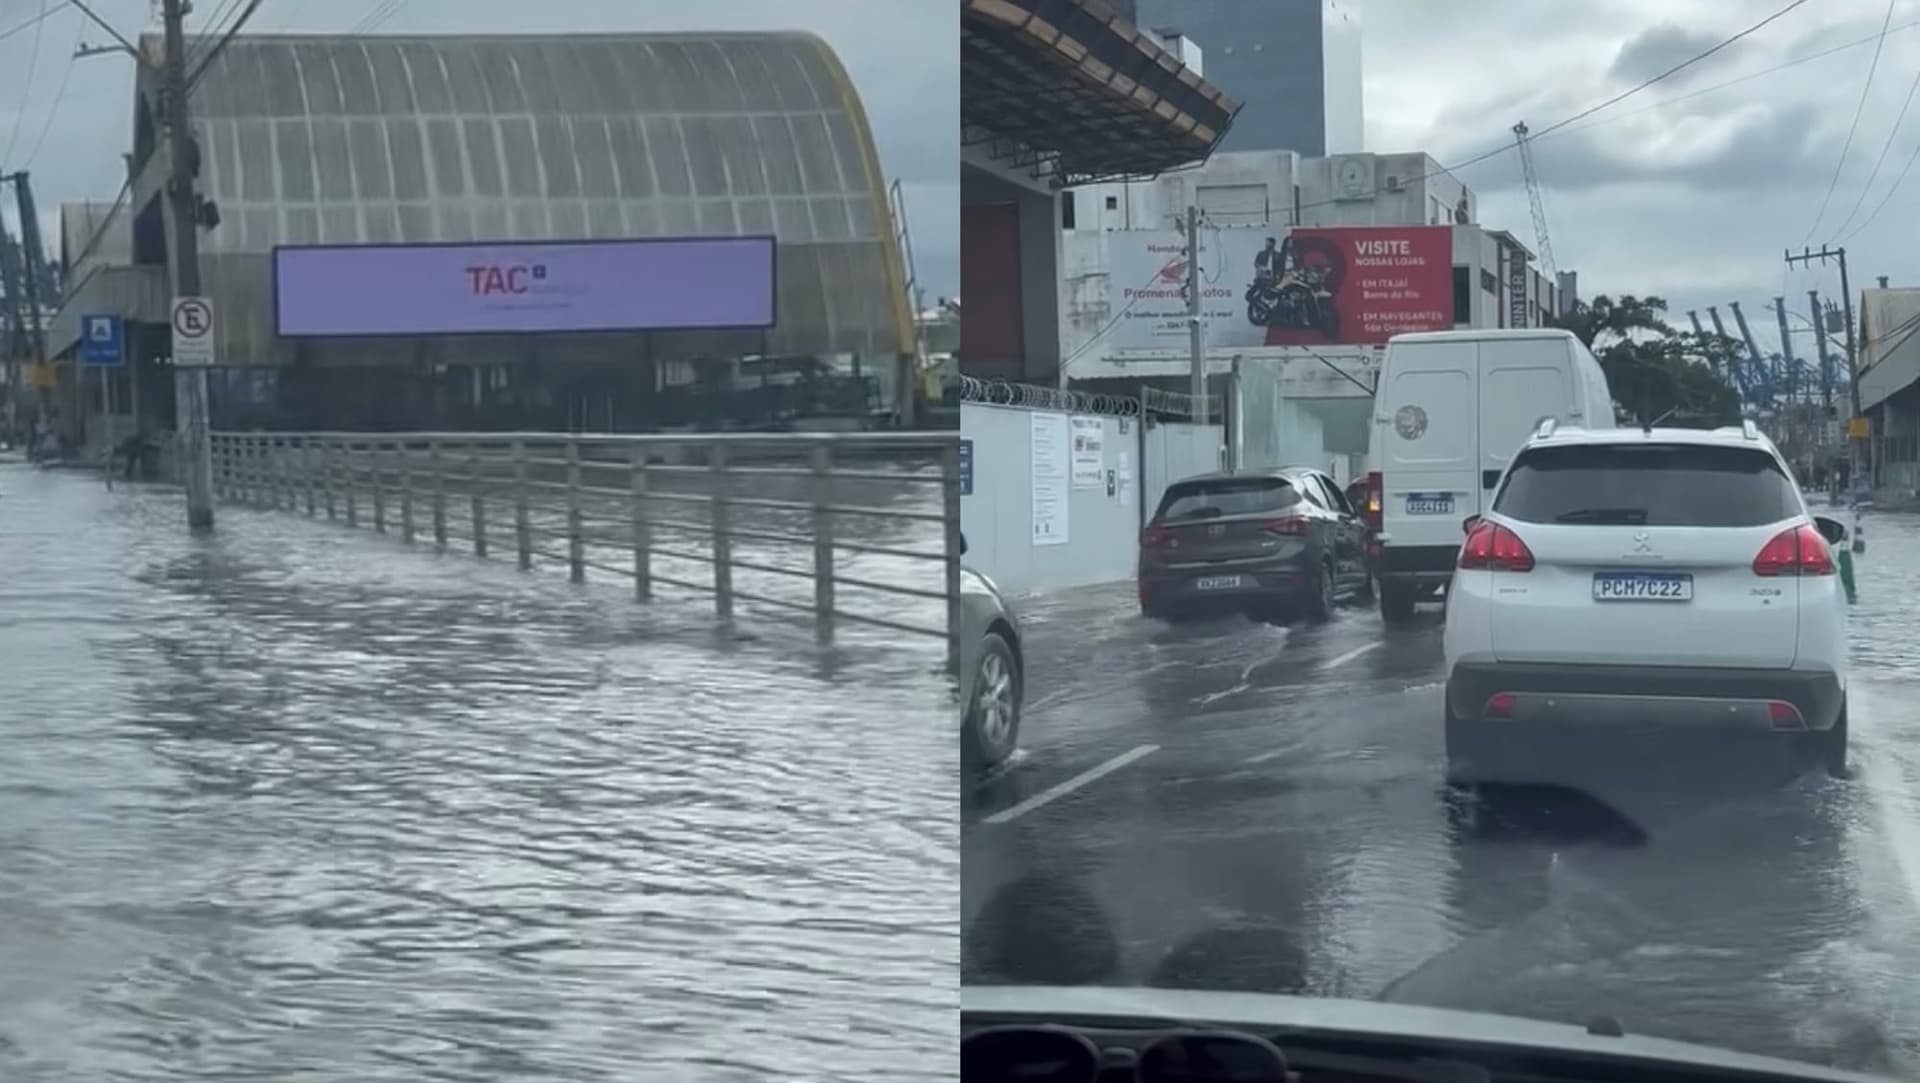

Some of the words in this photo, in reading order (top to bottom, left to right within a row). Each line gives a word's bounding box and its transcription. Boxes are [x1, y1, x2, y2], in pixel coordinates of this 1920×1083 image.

[1355, 240, 1412, 255] VISITE
[1355, 257, 1393, 266] NOSSAS
[465, 266, 529, 295] TAC
[1199, 288, 1232, 298] otos
[1379, 312, 1443, 321] NAVEGANTES
[1601, 580, 1682, 597] PCM7C22
